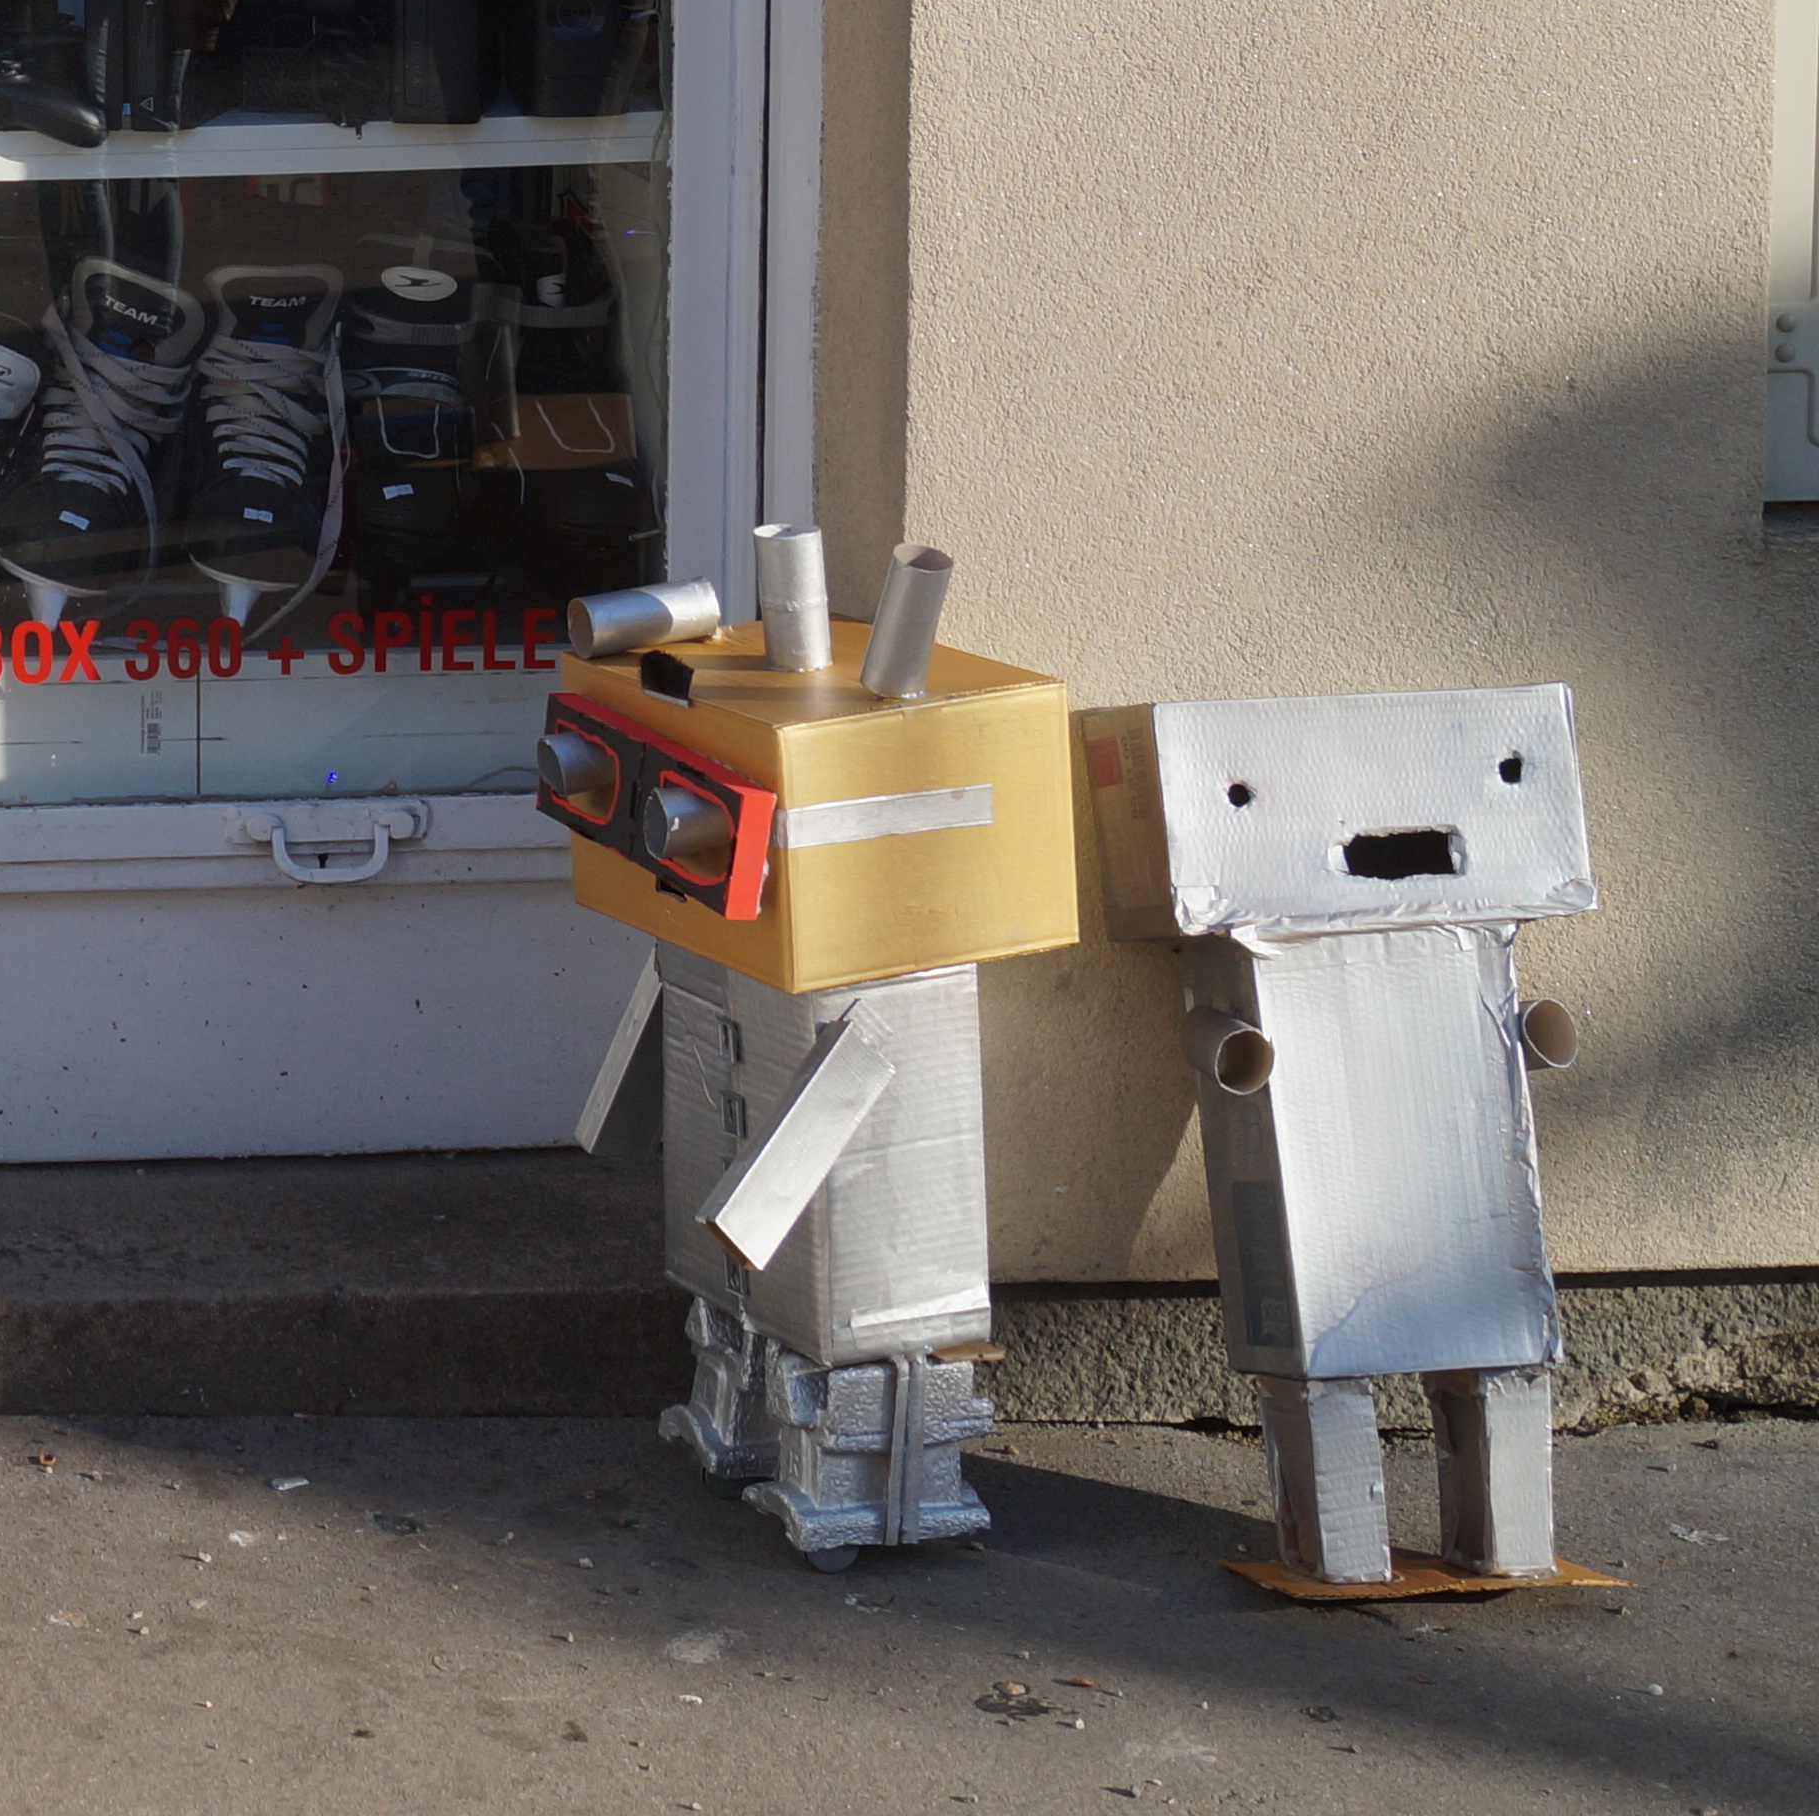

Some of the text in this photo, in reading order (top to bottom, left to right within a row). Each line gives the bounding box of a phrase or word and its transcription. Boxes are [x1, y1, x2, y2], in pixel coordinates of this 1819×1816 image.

[103, 294, 158, 325] TEAM
[248, 294, 307, 309] TEAM
[126, 617, 243, 681] 360
[268, 632, 304, 675] +
